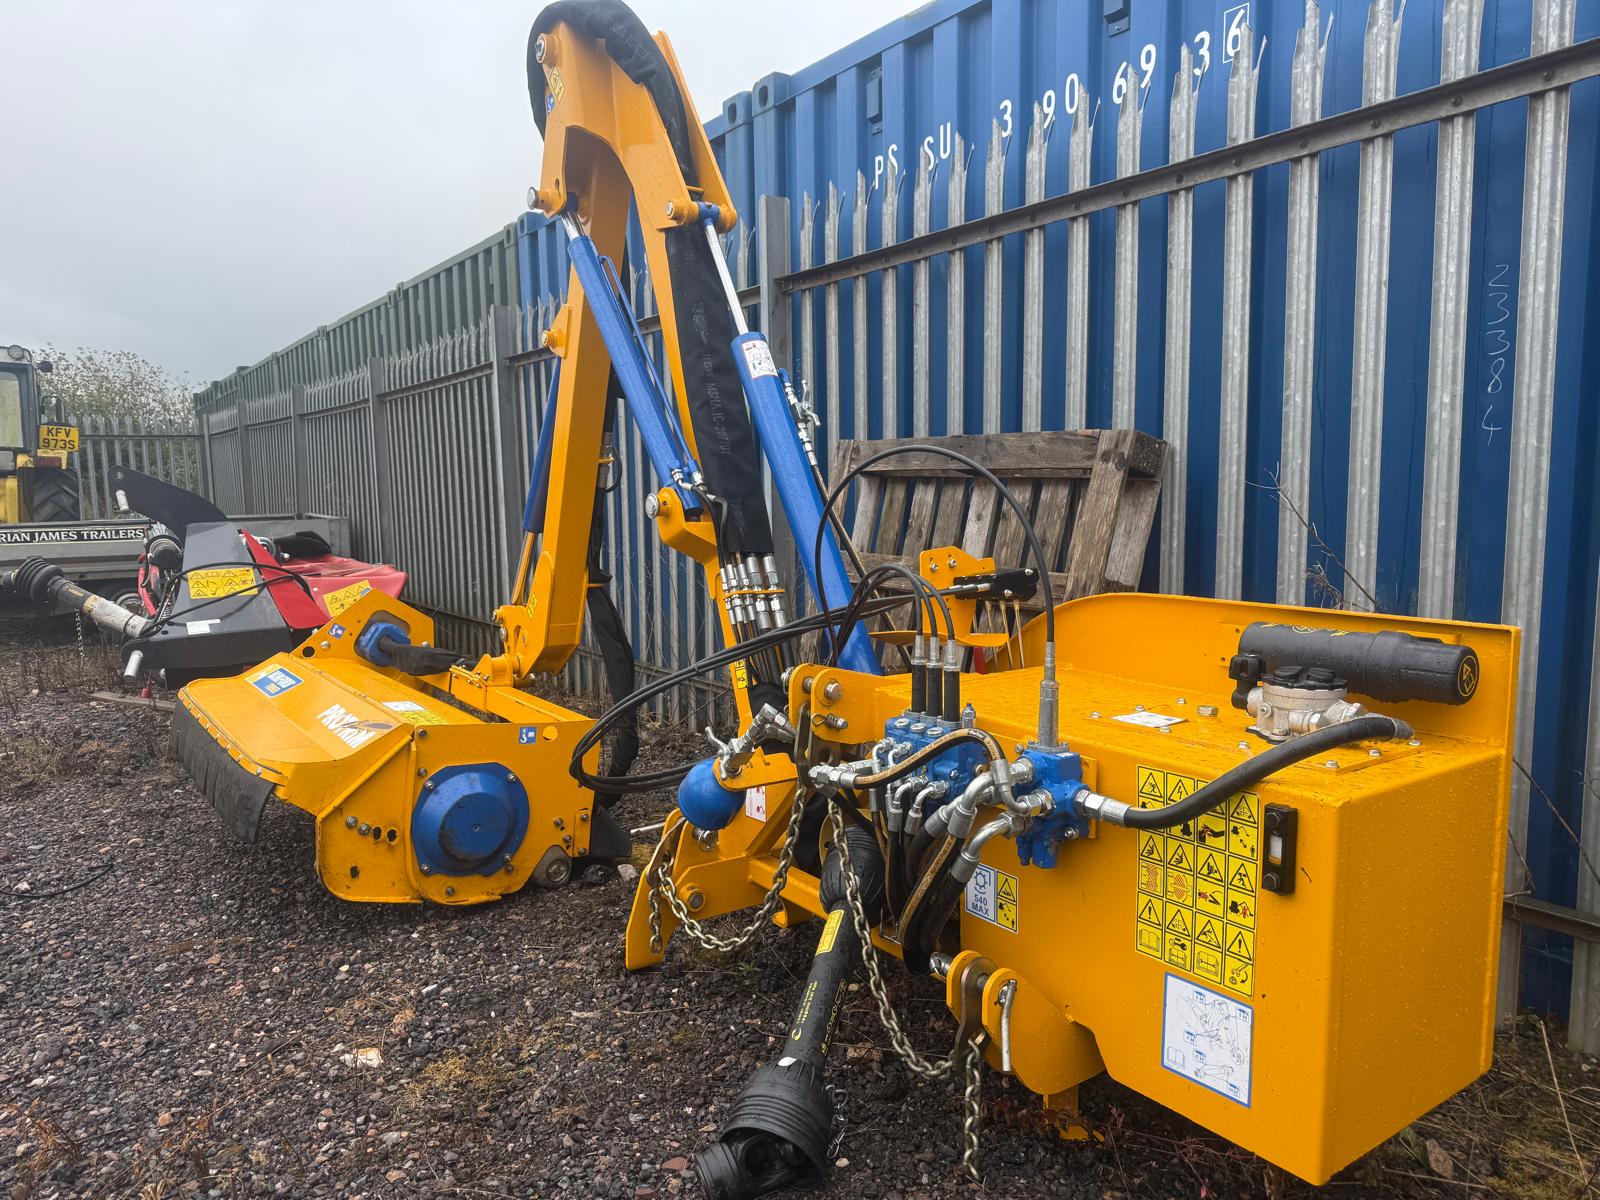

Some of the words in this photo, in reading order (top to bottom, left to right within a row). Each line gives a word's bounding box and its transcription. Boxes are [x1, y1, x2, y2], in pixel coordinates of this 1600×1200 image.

[46, 427, 72, 438] KFV
[42, 438, 76, 450] 973S
[33, 530, 78, 543] JAMES
[80, 529, 145, 540] TRAILERS
[974, 894, 988, 907] 540
[971, 902, 990, 917] MAX
